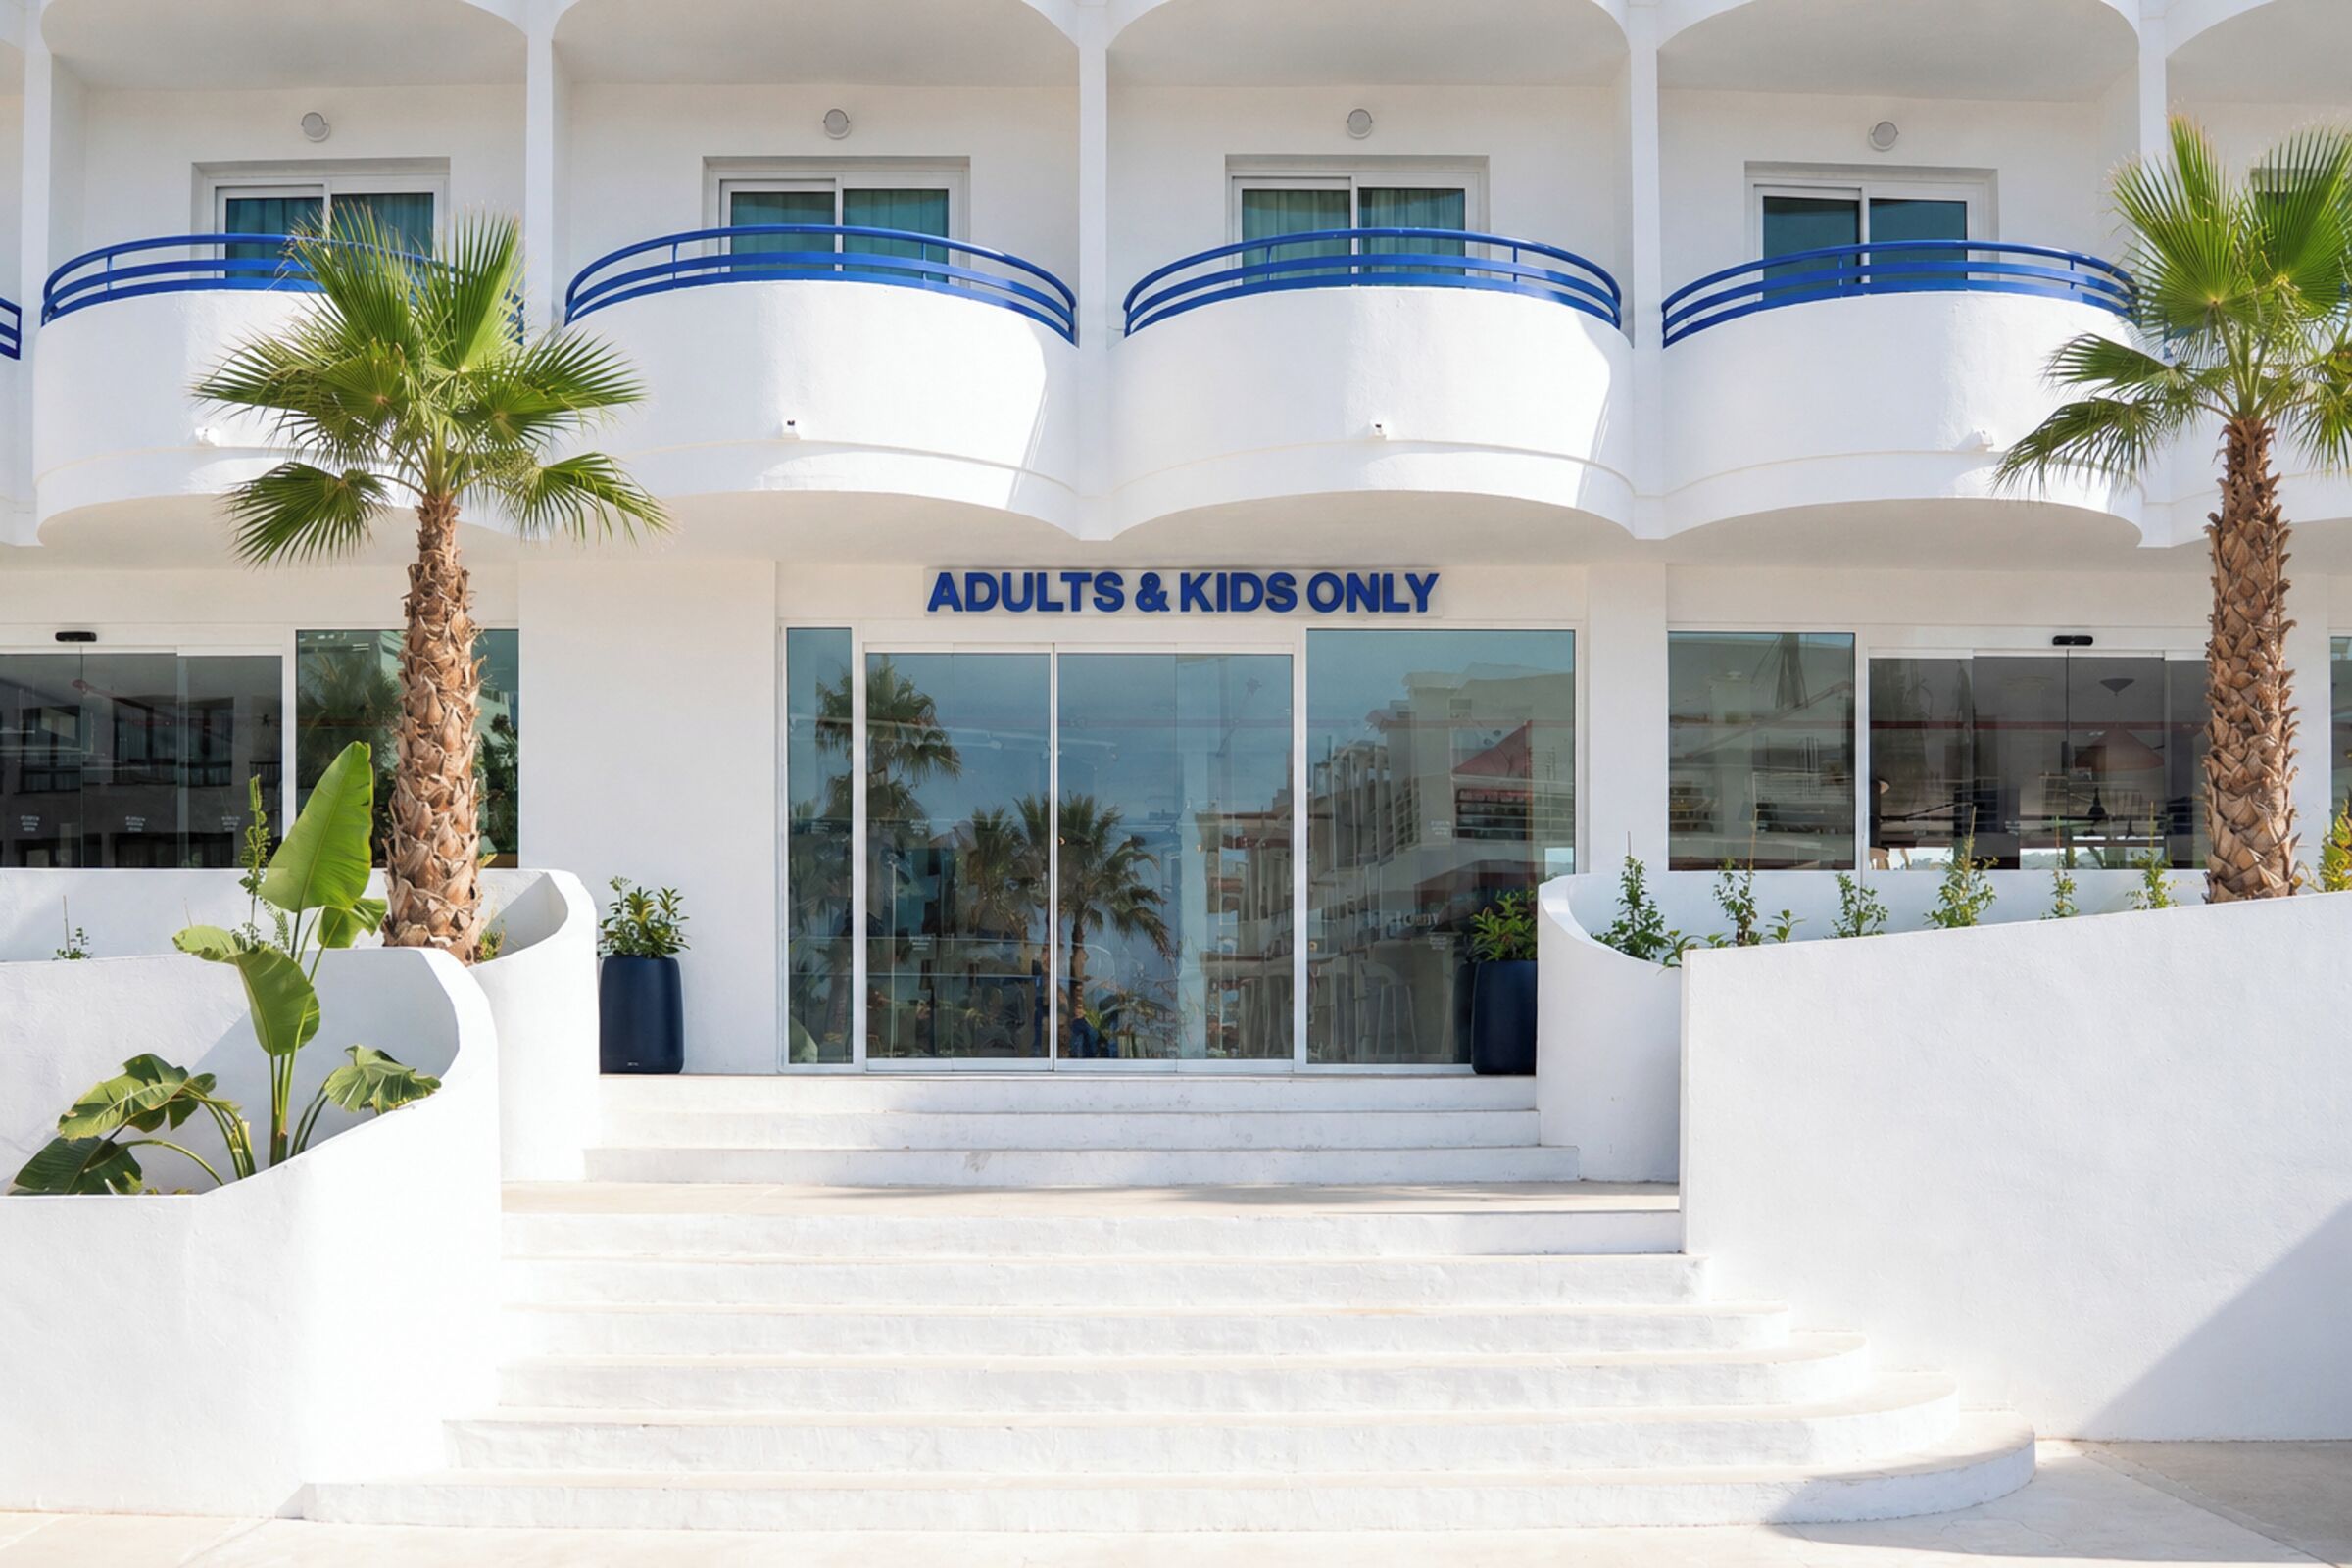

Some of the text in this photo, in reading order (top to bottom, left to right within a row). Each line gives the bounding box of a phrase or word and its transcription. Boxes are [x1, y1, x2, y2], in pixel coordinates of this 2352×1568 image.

[928, 572, 1440, 612] ADULTS & KIDS ONLY
